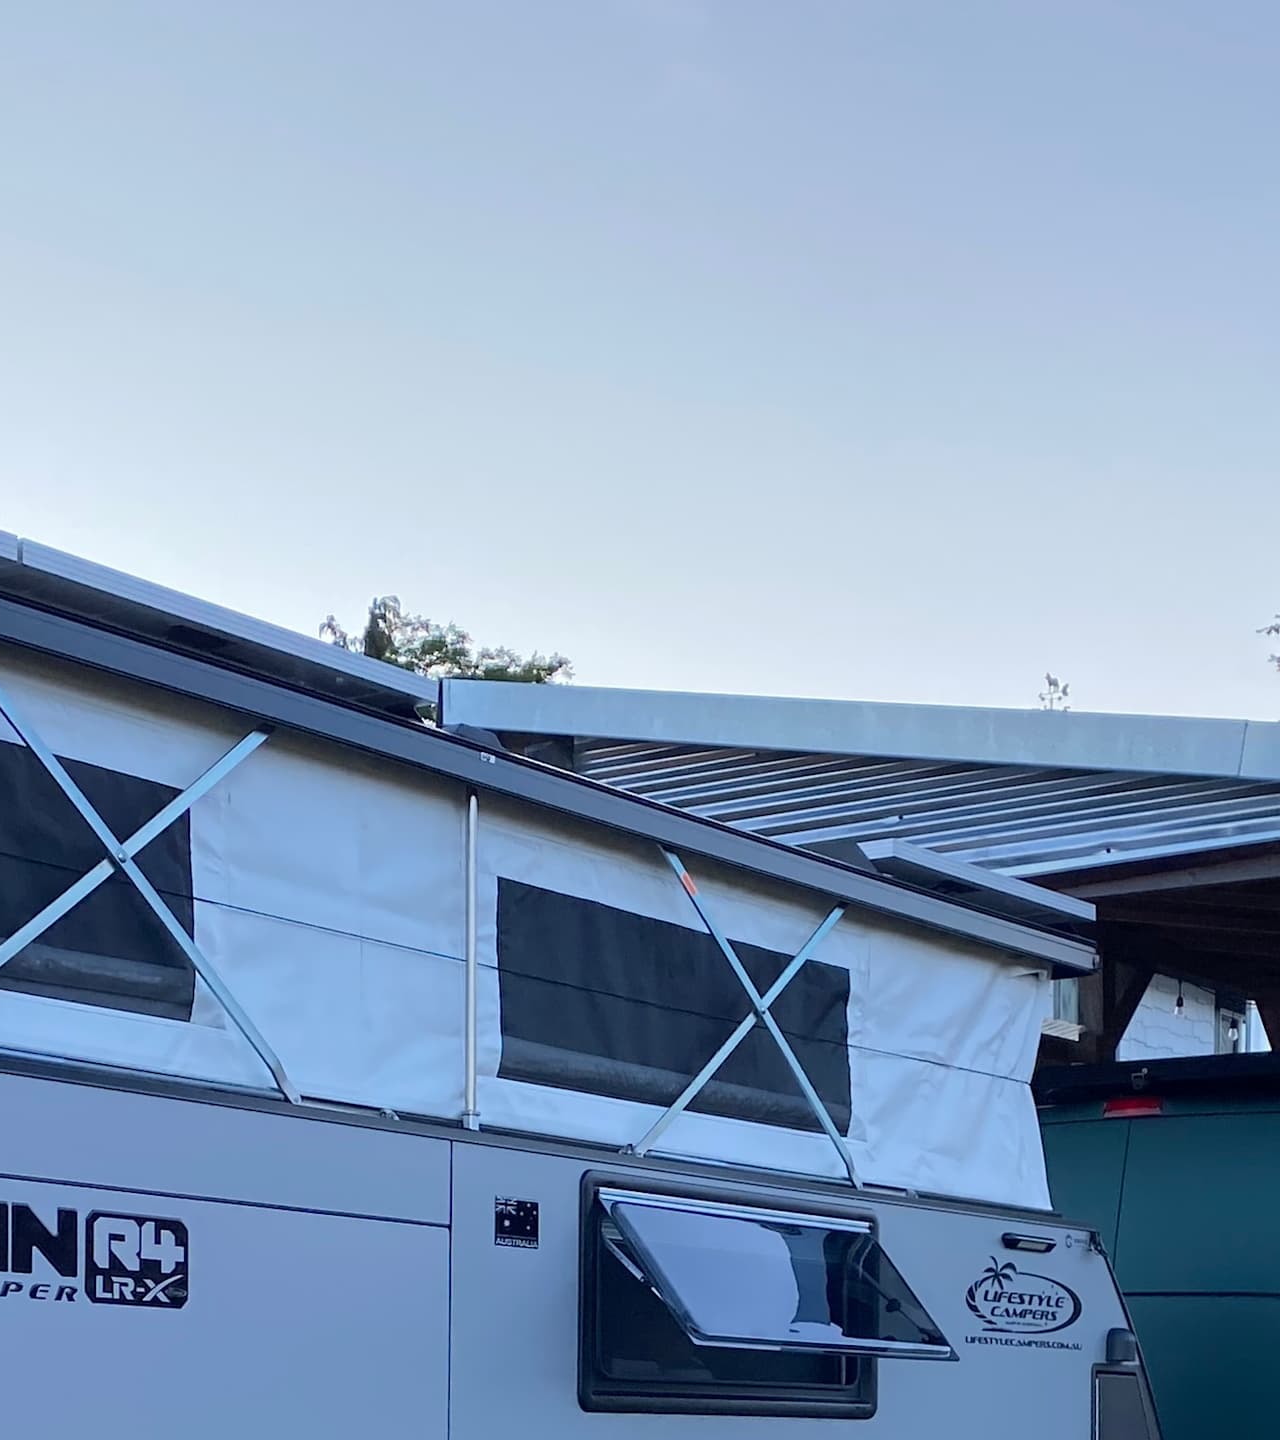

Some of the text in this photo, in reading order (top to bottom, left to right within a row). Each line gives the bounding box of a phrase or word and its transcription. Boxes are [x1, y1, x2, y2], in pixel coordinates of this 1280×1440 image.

[93, 1216, 185, 1274] R4
[495, 1237, 538, 1248] AUSTRALIA
[95, 1274, 184, 1303] LR-X
[983, 1289, 1066, 1309] LIFESTYLE
[990, 1306, 1059, 1321] CAMPERS
[965, 1335, 1082, 1351] LIFESTYLECAMPERS.COM.AU
